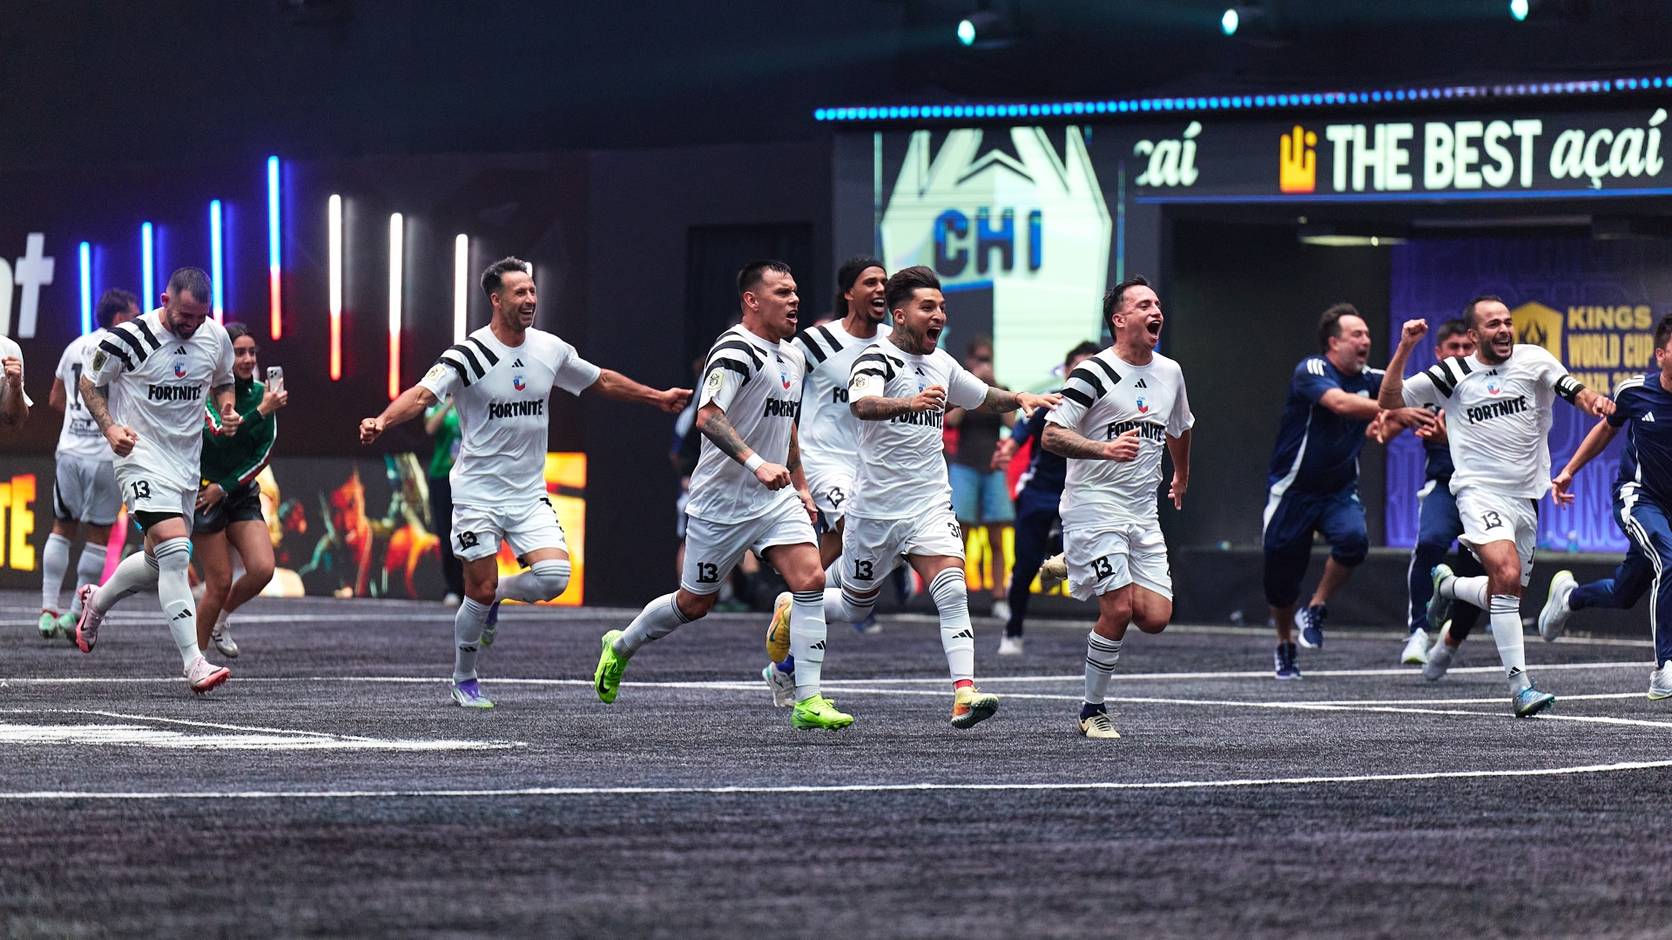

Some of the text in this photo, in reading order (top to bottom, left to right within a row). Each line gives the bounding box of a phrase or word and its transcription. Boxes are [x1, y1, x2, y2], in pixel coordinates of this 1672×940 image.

[1326, 108, 1668, 192] THE BEST açaí
[934, 206, 1042, 278] CHI
[1567, 305, 1652, 330] KINGS
[1567, 333, 1655, 368] WORLD CUP
[489, 399, 544, 420] FORTNITE
[1467, 395, 1527, 424] FORTNITE
[131, 480, 151, 500] 13
[827, 487, 844, 509] 13
[1480, 511, 1504, 531] 13
[457, 531, 480, 552] 13
[696, 562, 719, 583] 13
[853, 559, 874, 580] 13
[1091, 556, 1116, 583] 13
